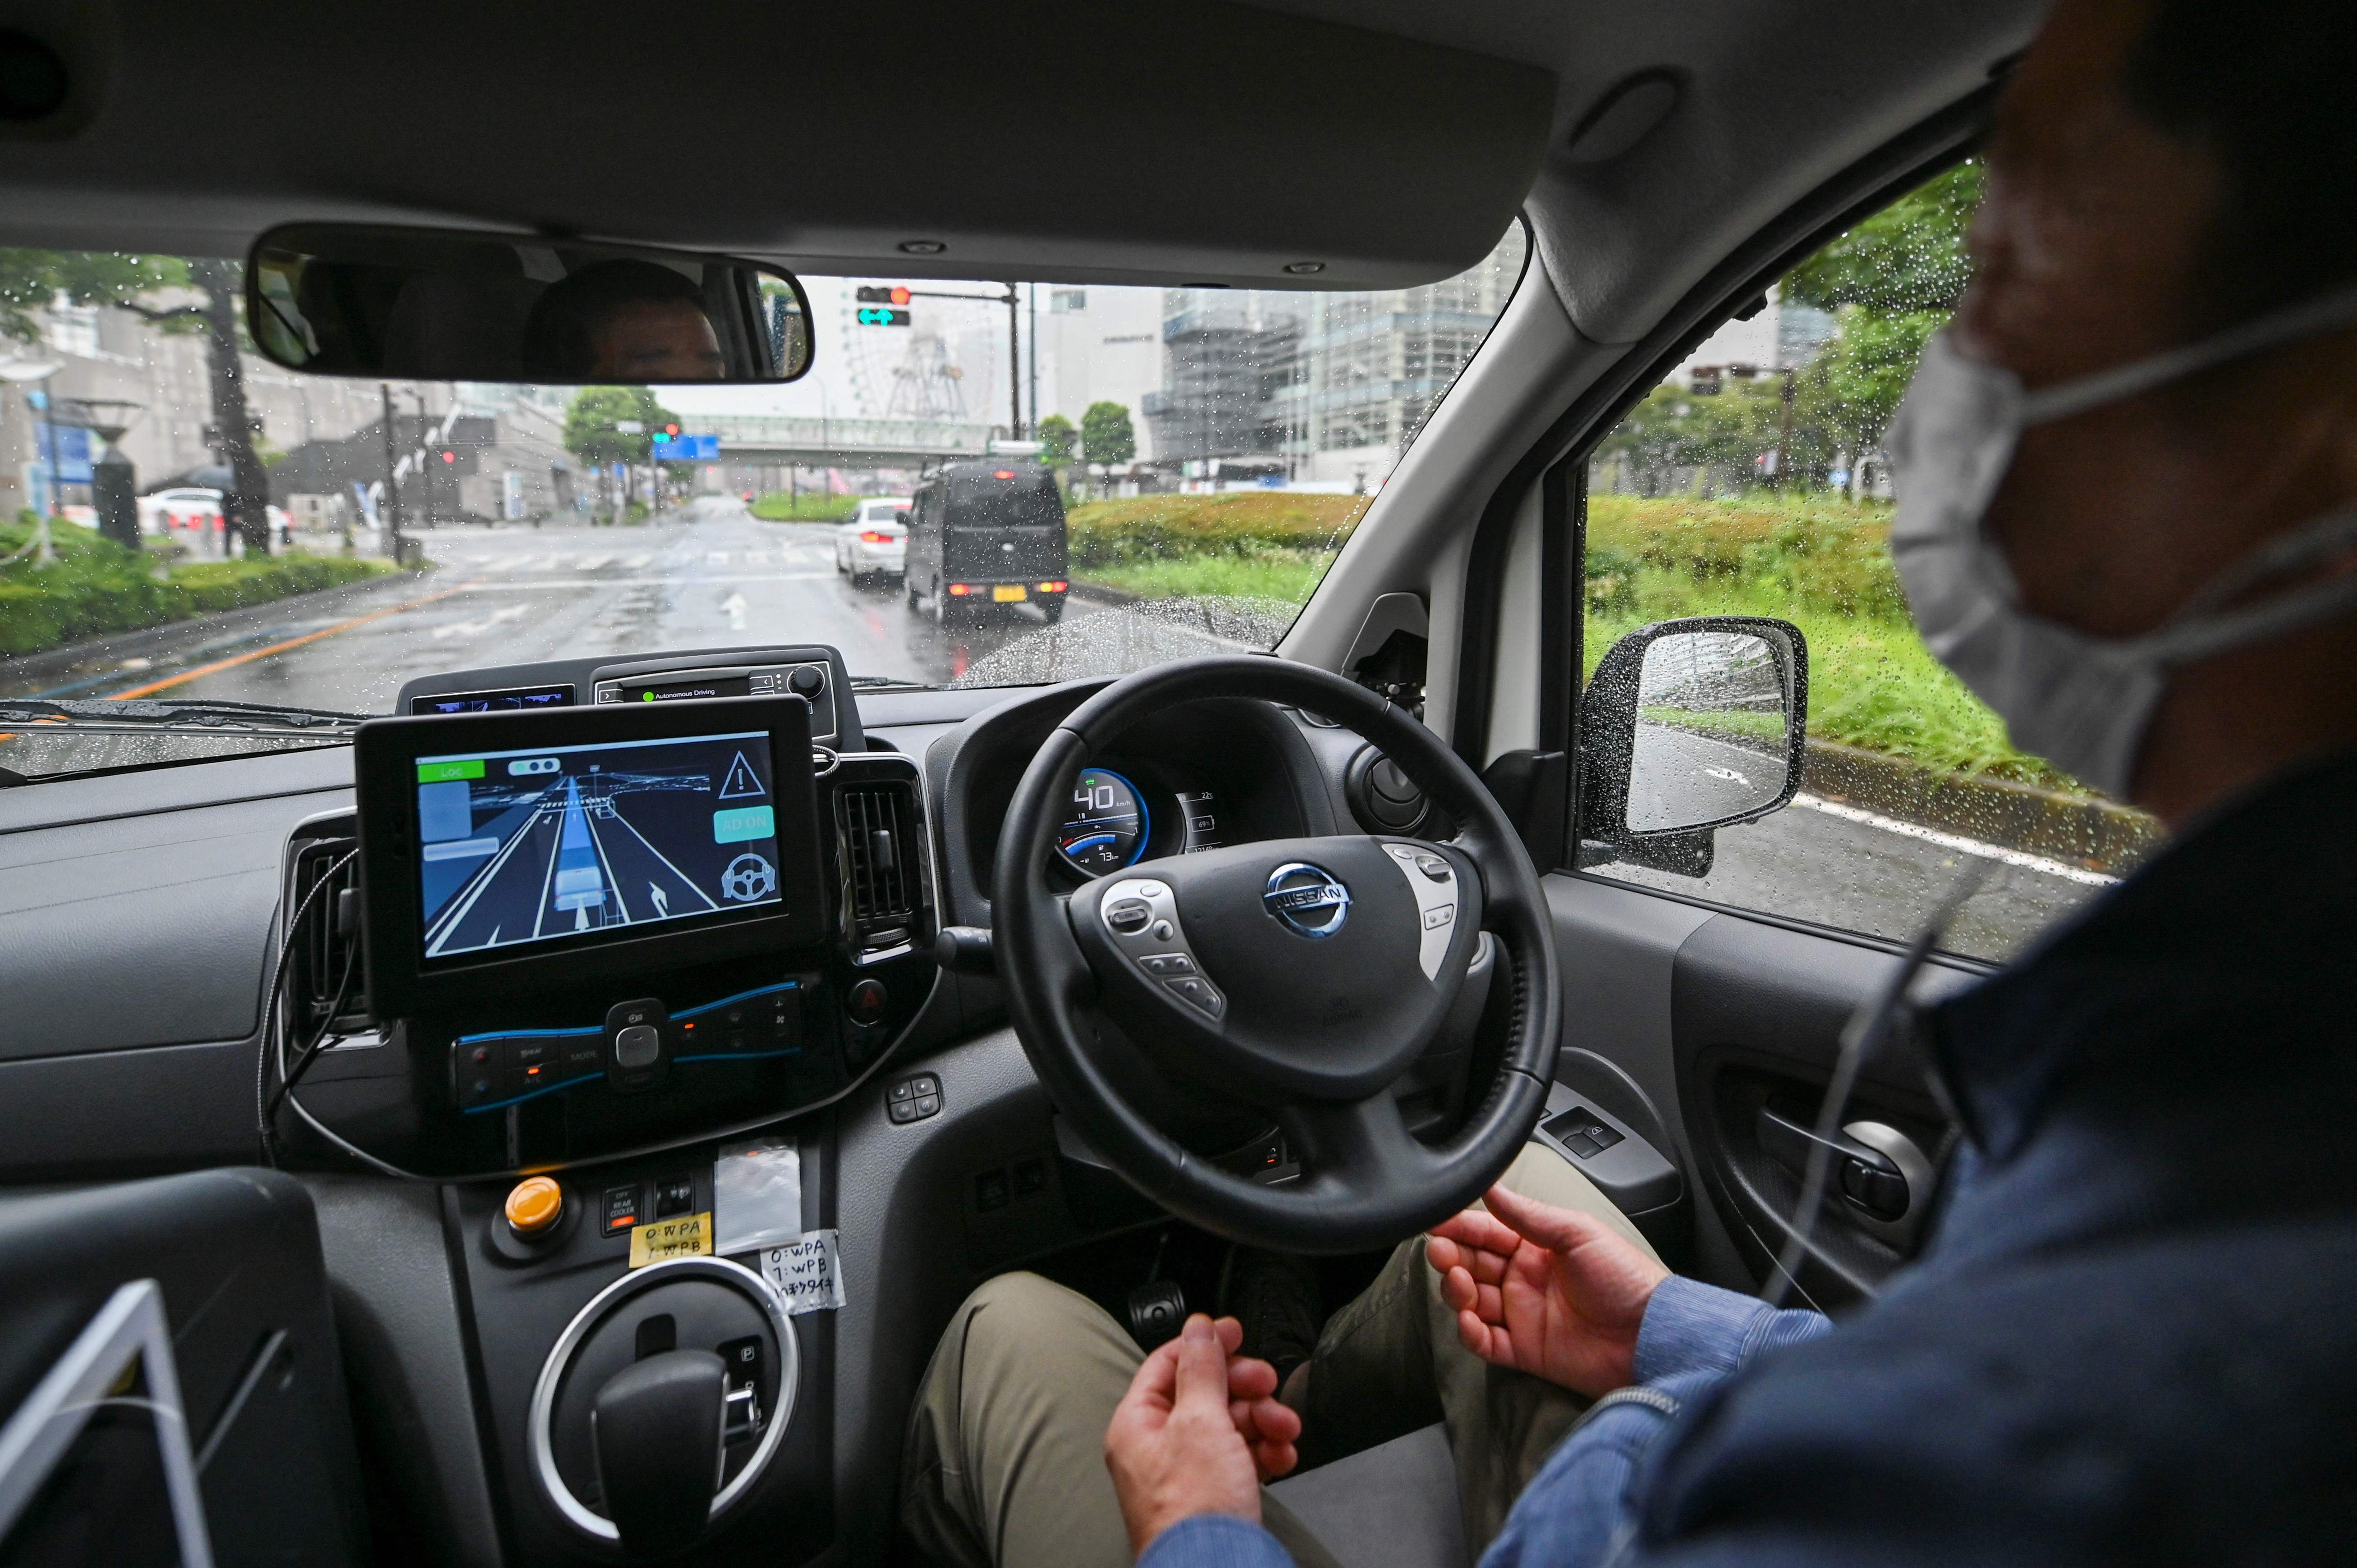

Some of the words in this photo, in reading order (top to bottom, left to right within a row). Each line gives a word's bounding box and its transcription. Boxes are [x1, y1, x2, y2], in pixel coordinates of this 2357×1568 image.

[655, 690, 693, 699] Autonomous
[694, 689, 715, 697] Driving
[1074, 785, 1114, 810] 40
[722, 818, 742, 832] AD
[746, 815, 766, 829] ON
[1274, 887, 1342, 910] NISSAN
